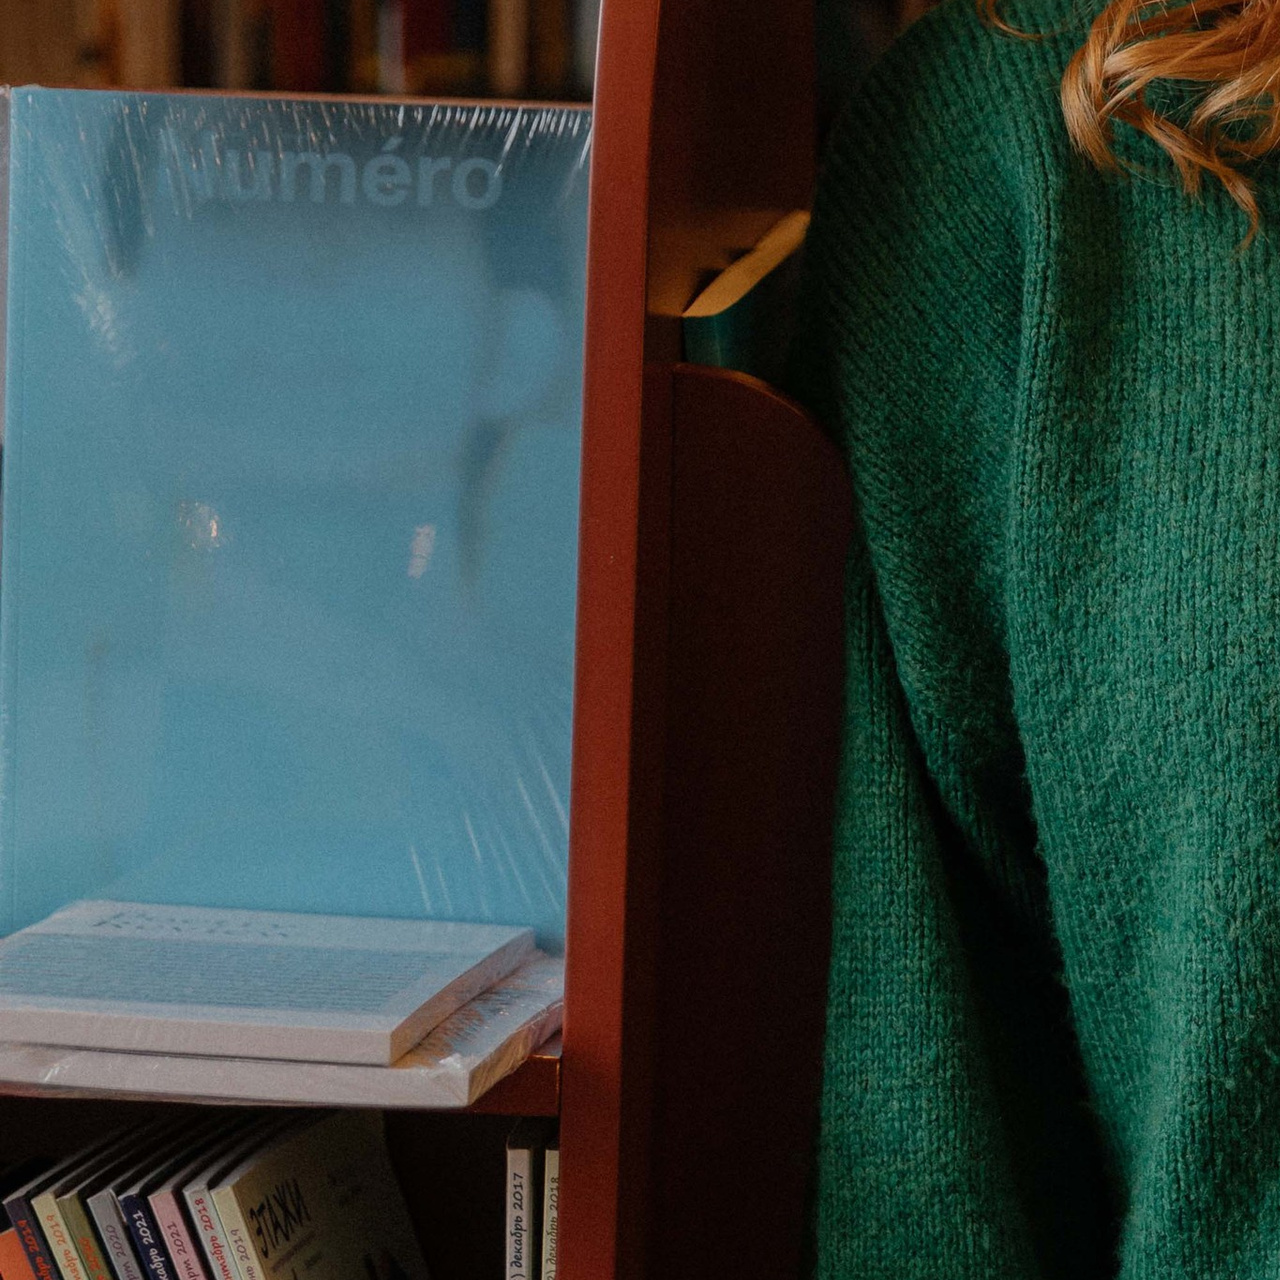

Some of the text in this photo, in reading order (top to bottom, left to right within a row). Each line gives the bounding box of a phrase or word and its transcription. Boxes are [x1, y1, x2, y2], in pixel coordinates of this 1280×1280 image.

[513, 1173, 525, 1209] 2017
[550, 1176, 560, 1211] 2018
[47, 1215, 66, 1245] 2019
[133, 1209, 154, 1245] 2021
[195, 1198, 214, 1231] 2018
[106, 1225, 126, 1258] 2020
[167, 1222, 187, 1256] 2021
[231, 1229, 250, 1262] 2019
[510, 1215, 527, 1269] декабрь
[546, 1216, 558, 1271] декабрь
